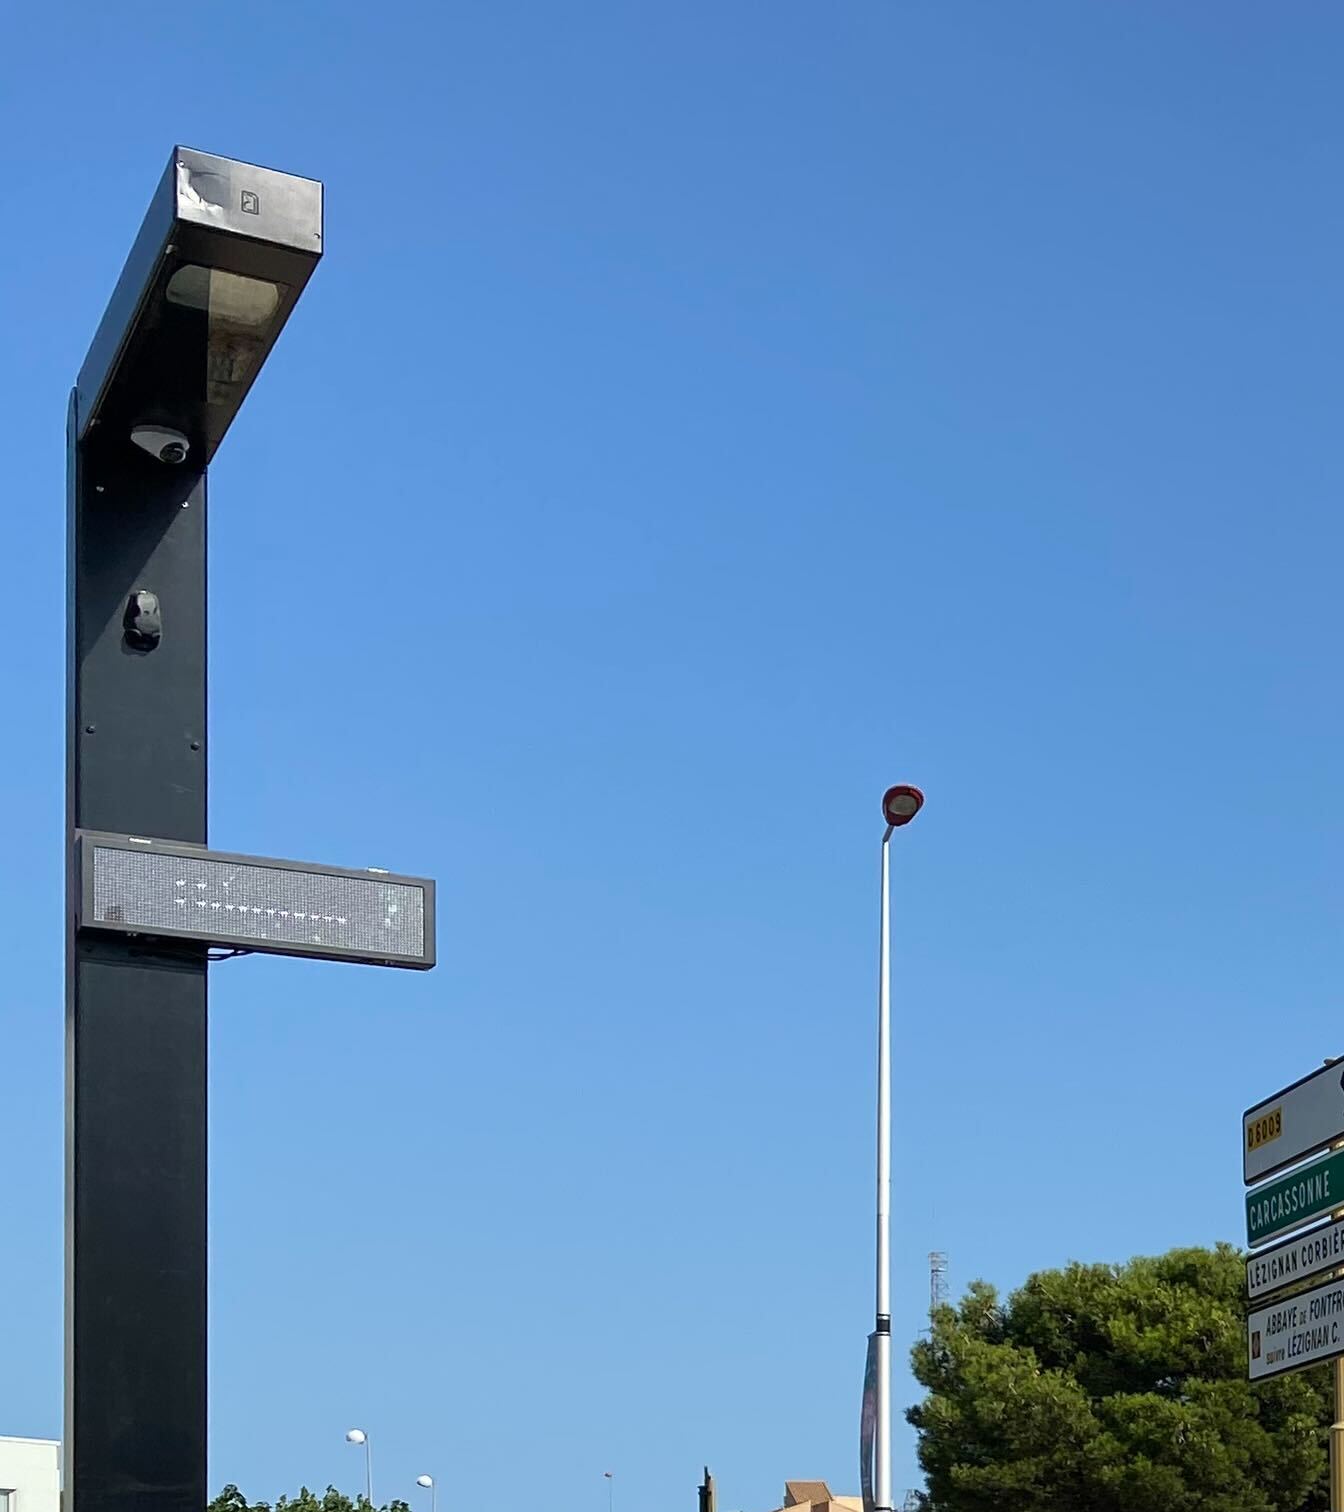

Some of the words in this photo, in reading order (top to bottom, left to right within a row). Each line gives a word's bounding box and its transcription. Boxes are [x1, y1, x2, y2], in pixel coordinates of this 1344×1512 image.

[1255, 1112, 1281, 1143] 6009
[1250, 1170, 1330, 1231] CARCASSONNE
[1250, 1249, 1298, 1289] LÉZIGNAN
[1265, 1306, 1298, 1336] ABBAYE
[1266, 1347, 1286, 1365] suivre
[1287, 1325, 1329, 1357] LÉZIGNAN
[1331, 1321, 1341, 1343] C.
